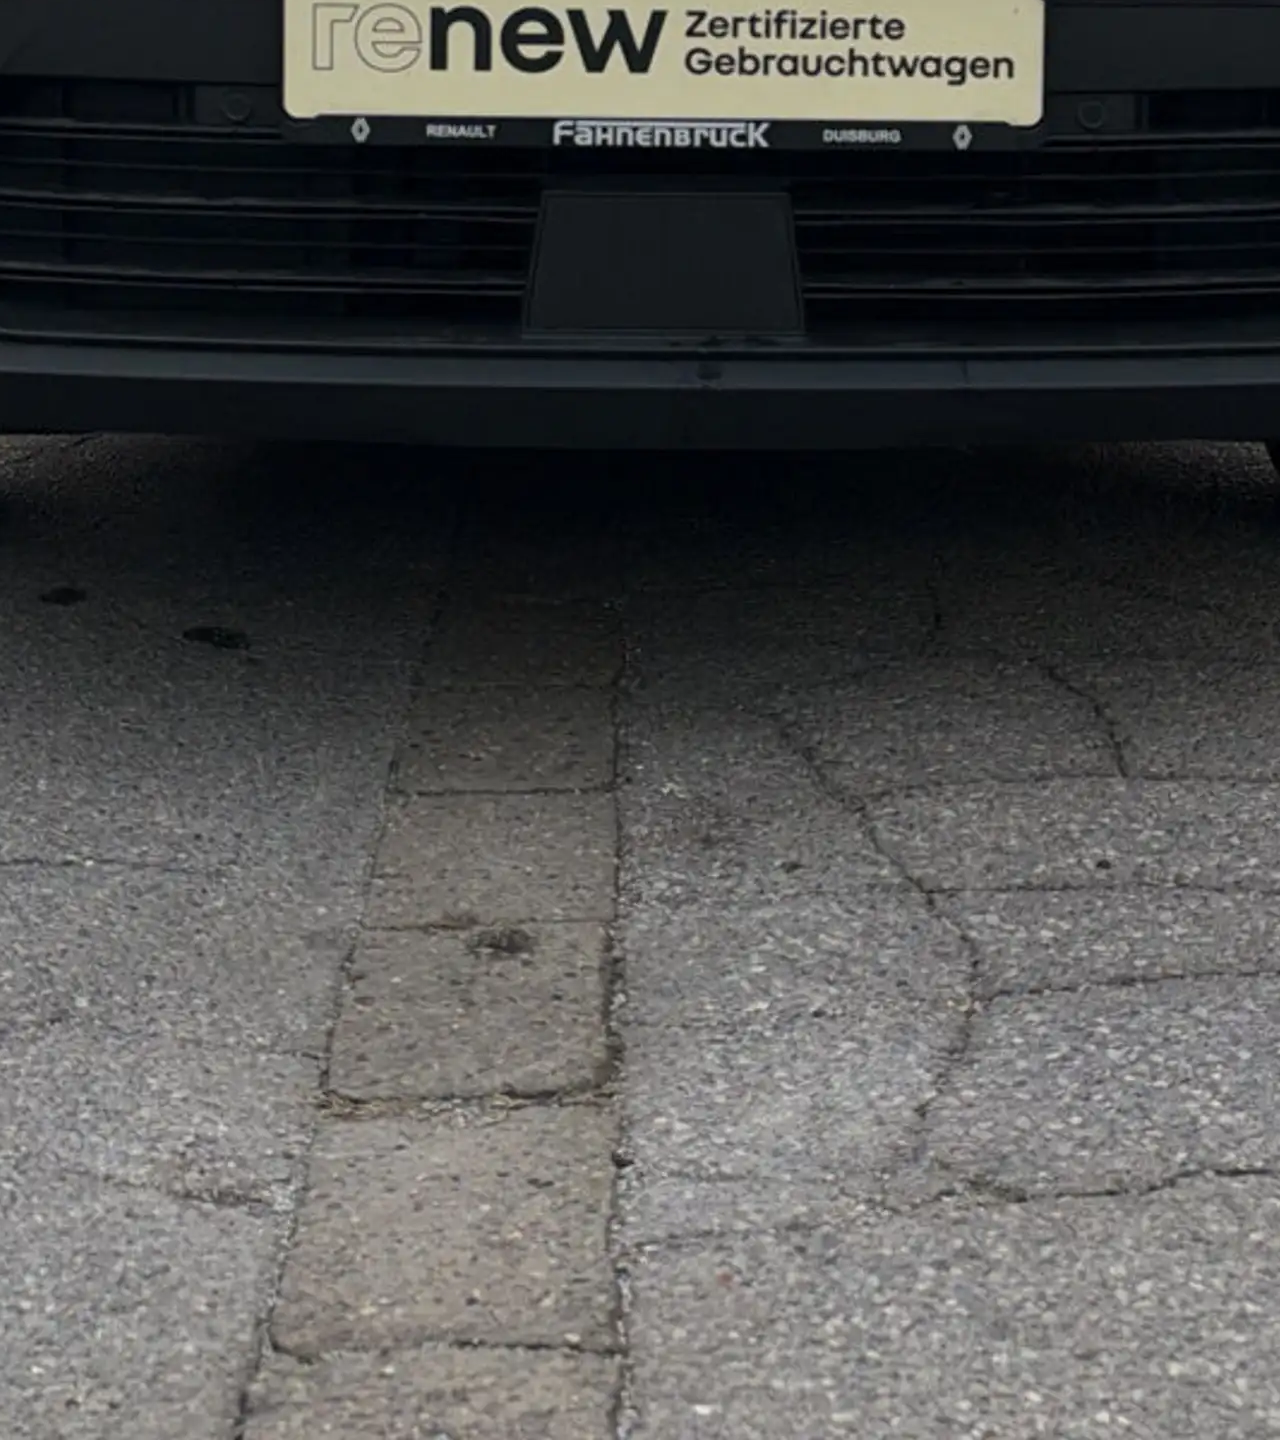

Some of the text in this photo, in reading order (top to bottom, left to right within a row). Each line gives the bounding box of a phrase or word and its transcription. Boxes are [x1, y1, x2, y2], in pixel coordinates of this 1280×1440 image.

[312, 2, 669, 74] renew
[685, 9, 906, 40] Zertifizierte
[684, 46, 1015, 86] Gebrauchtwagen
[426, 124, 497, 140] RENAULT
[822, 128, 903, 144] DUISBURG
